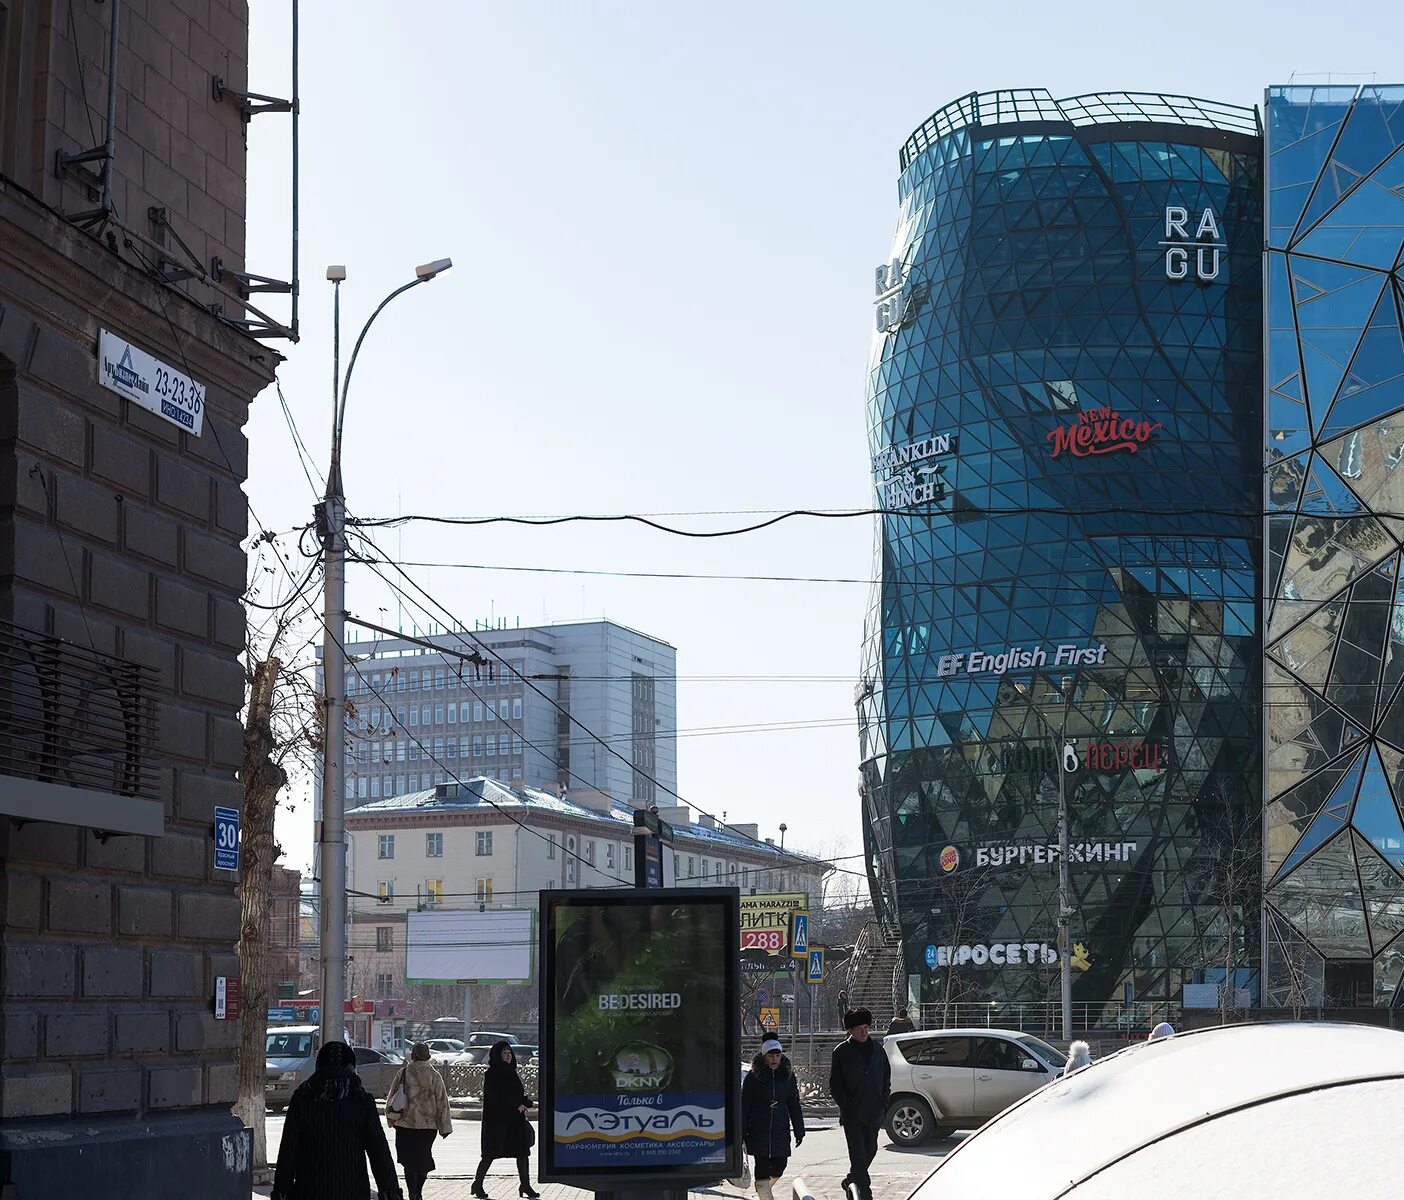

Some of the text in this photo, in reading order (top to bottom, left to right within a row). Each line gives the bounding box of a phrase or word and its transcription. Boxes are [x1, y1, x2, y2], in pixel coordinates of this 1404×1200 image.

[1166, 207, 1219, 238] RA
[1166, 248, 1219, 279] GU
[155, 367, 201, 415] 23-23-36
[1079, 406, 1112, 424] NEW
[1046, 411, 1161, 457] Mexico
[870, 433, 951, 474] FRANKLIN
[903, 466, 916, 485] &
[886, 482, 935, 510] FINCH
[967, 647, 1047, 674] English
[1054, 644, 1107, 666] First
[218, 822, 236, 849] 30
[976, 843, 1136, 867] БУРГЕР КИНГ
[760, 900, 793, 908] MARAZZI
[746, 932, 780, 950] 288
[927, 948, 935, 958] 24
[616, 1077, 664, 1088] DKNY
[617, 1094, 655, 1106] Только
